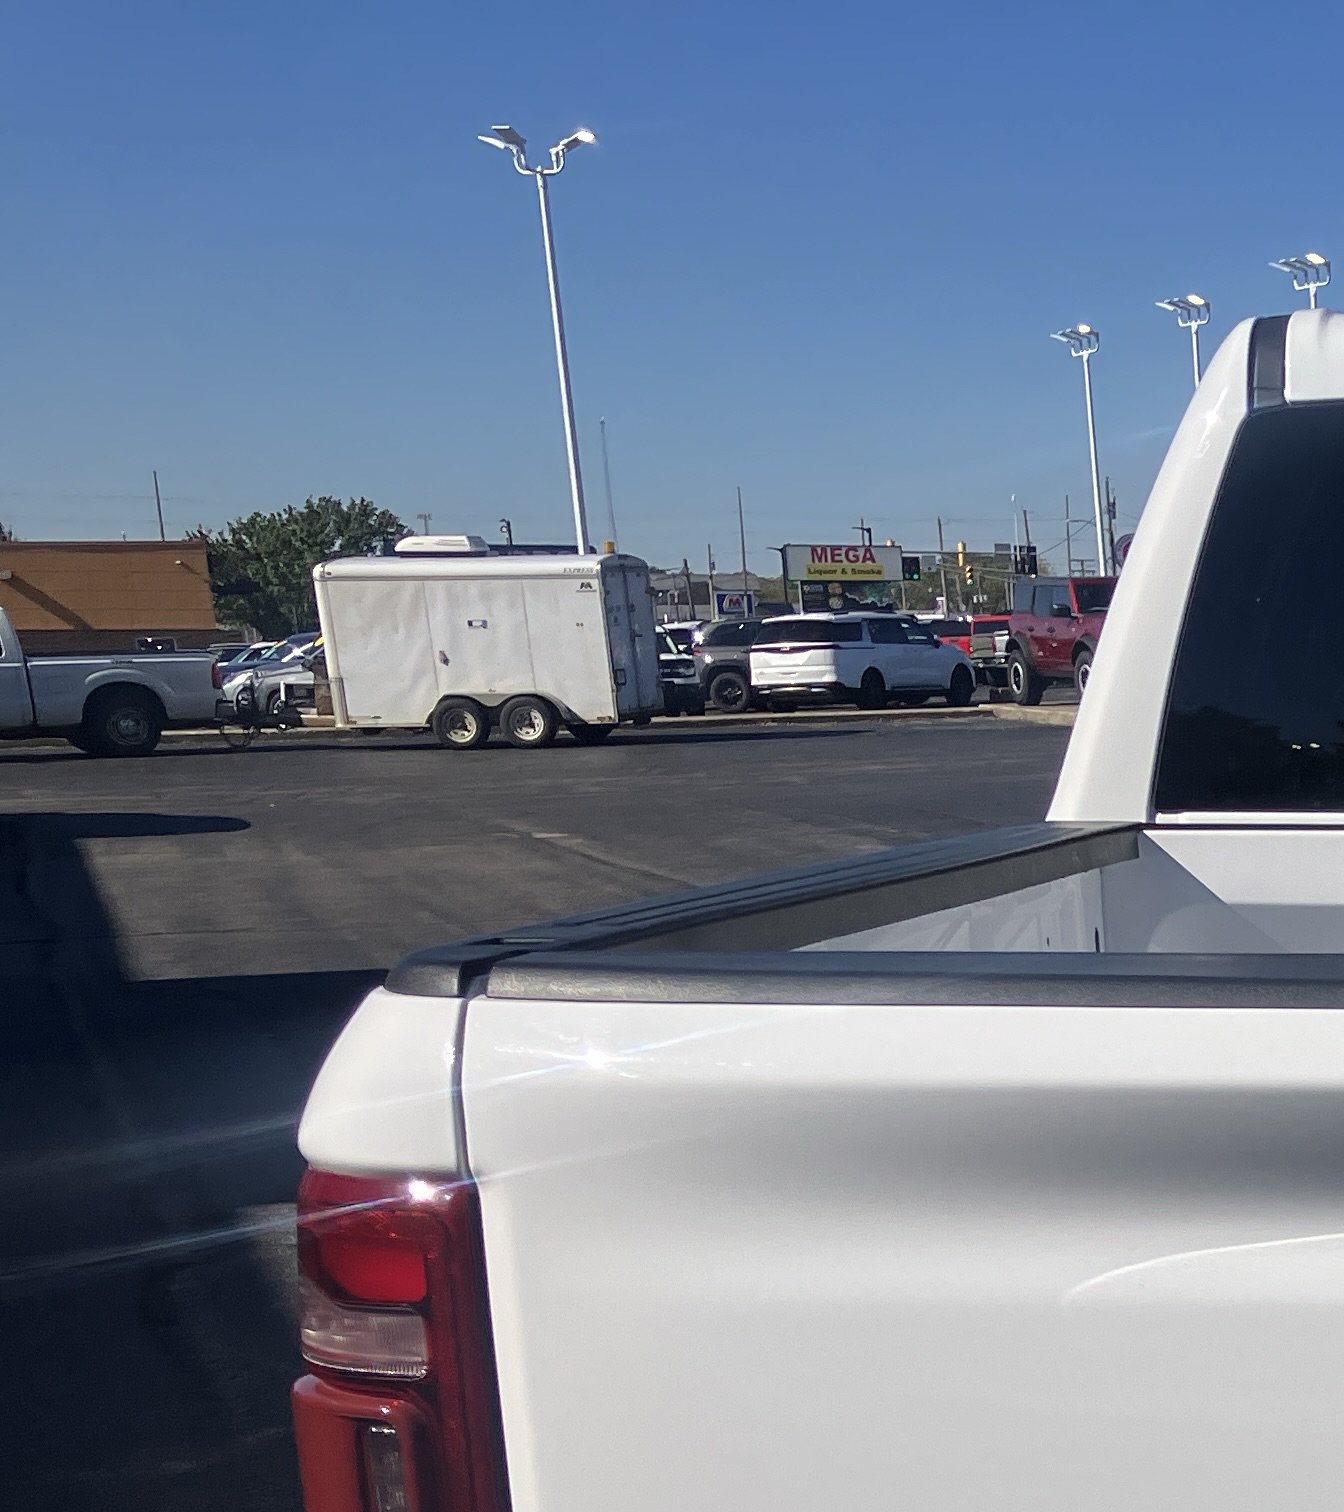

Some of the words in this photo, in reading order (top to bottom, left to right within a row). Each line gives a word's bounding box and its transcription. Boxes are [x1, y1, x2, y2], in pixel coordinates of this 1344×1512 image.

[811, 546, 877, 564] MEGA
[807, 567, 838, 576] Liquor
[841, 567, 848, 575] &
[851, 567, 883, 576] Smoke
